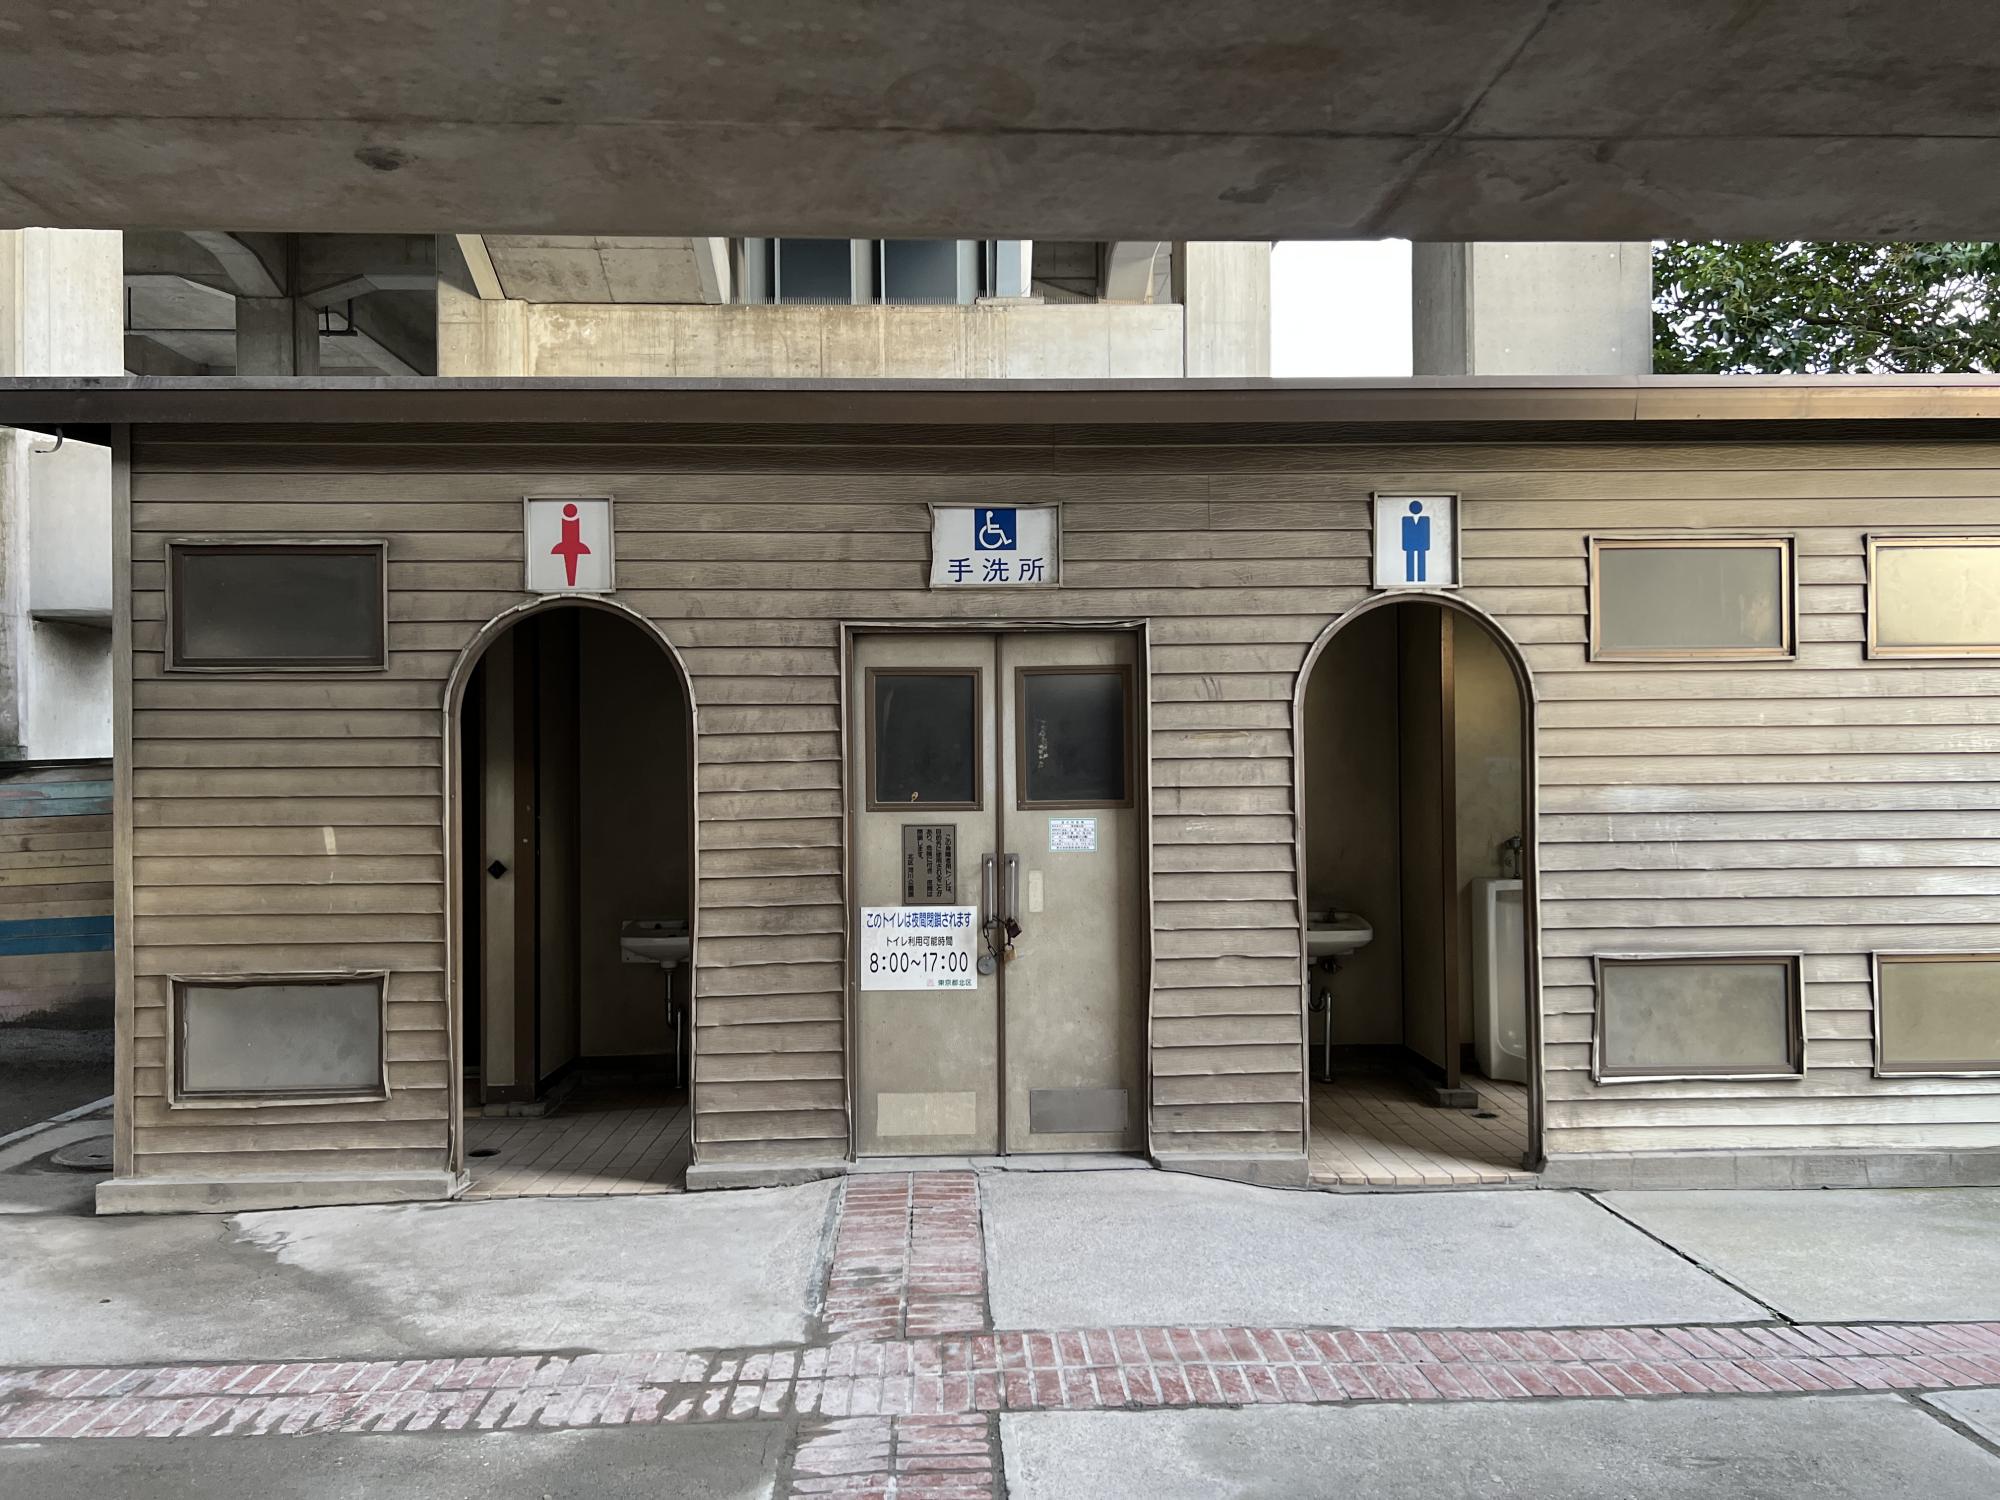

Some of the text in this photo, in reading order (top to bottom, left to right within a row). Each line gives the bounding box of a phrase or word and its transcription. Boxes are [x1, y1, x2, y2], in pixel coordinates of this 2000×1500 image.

[947, 557, 1045, 583] 手洗所
[866, 911, 973, 928] このトイレは夜間閉鎖されます
[886, 935, 954, 947] トイレ利用可能時間
[938, 978, 972, 987] 東京都北区
